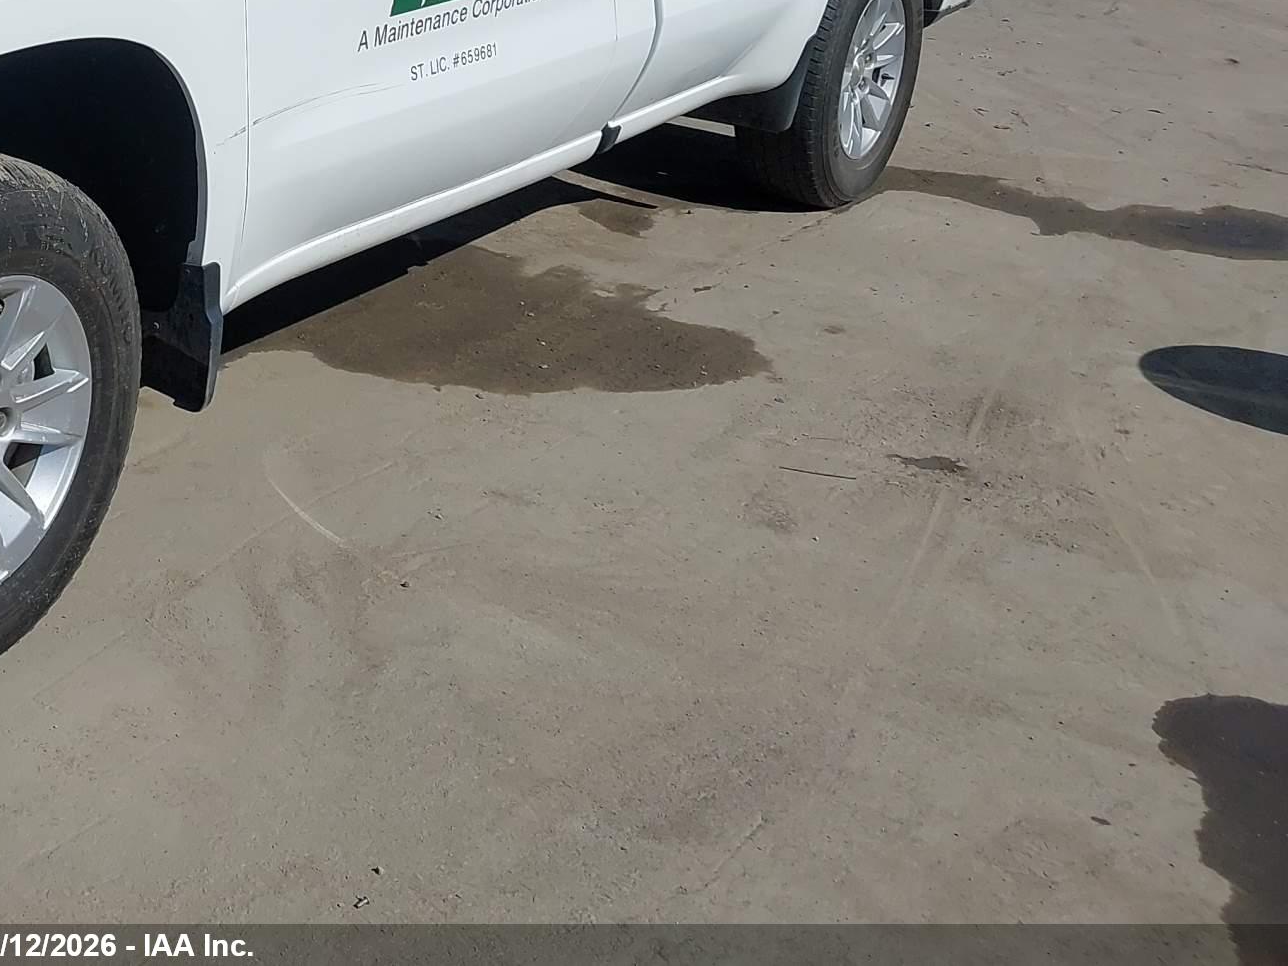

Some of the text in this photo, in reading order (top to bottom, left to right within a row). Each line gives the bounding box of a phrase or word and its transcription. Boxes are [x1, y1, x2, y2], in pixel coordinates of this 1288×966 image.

[357, 30, 369, 52] A
[373, 6, 468, 47] Maintenance
[430, 56, 450, 75] LIC.
